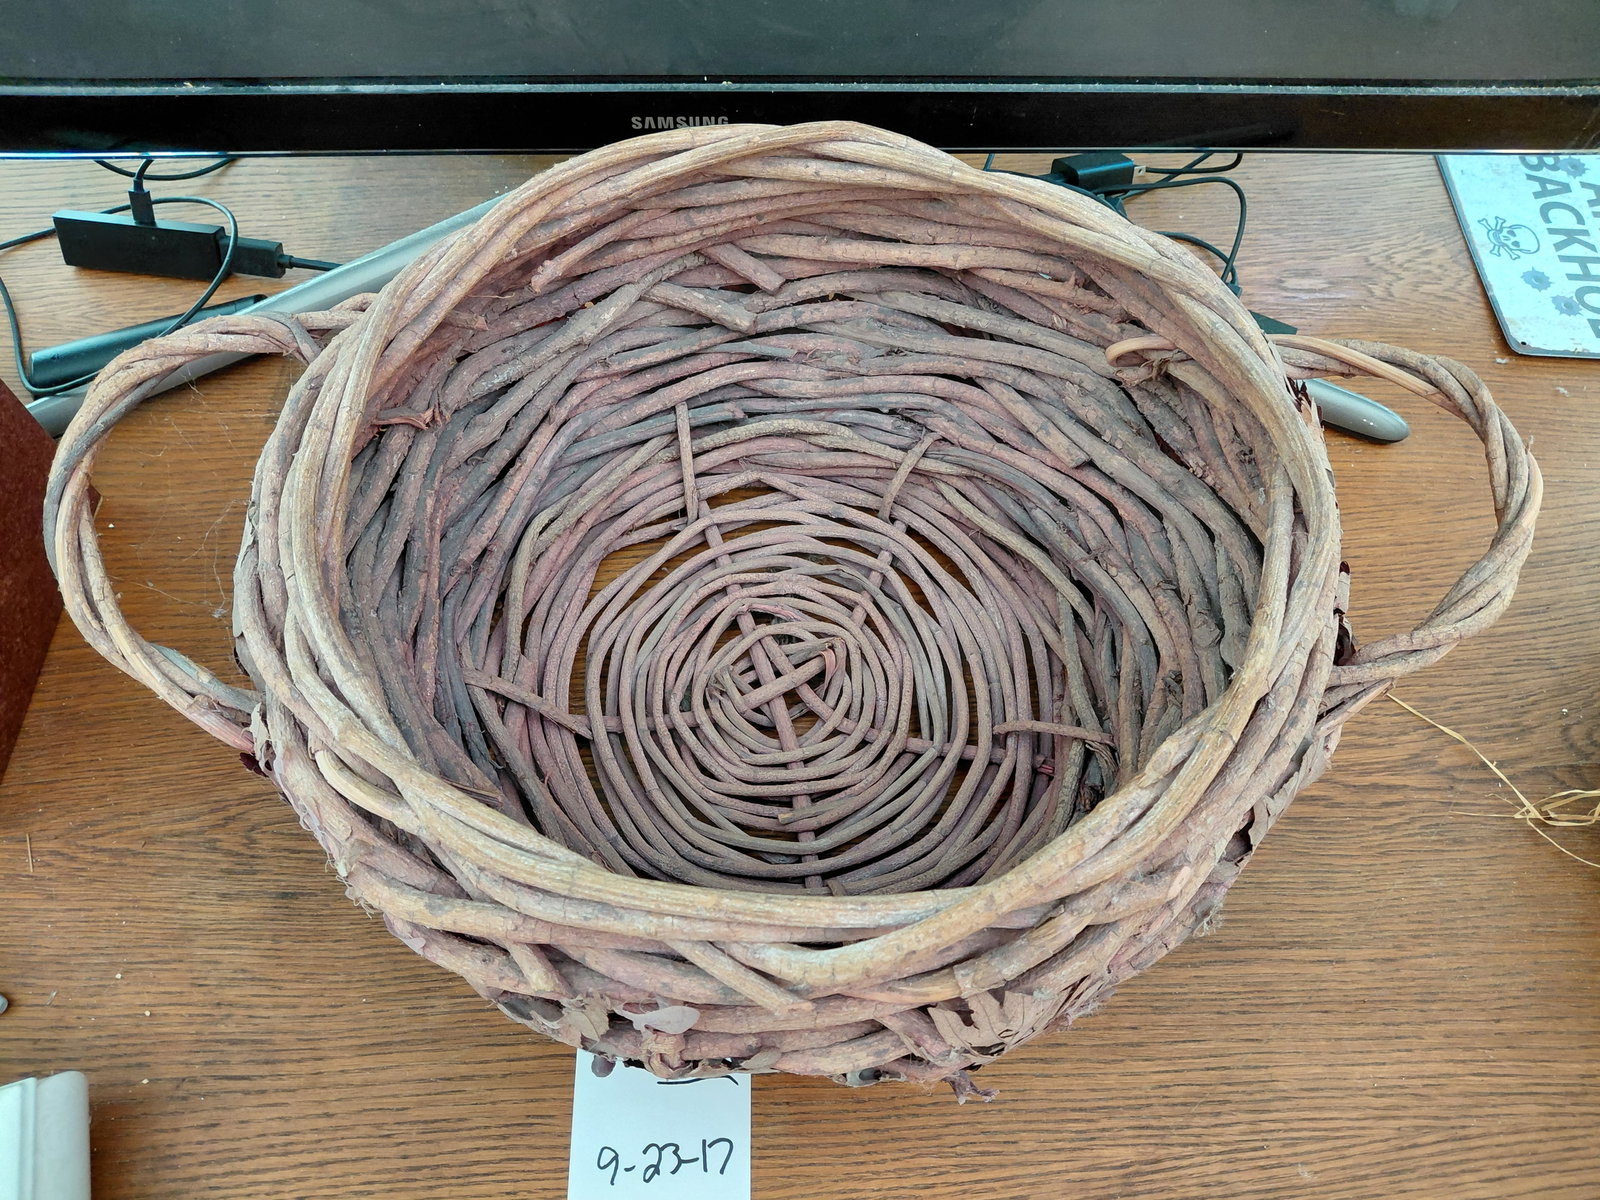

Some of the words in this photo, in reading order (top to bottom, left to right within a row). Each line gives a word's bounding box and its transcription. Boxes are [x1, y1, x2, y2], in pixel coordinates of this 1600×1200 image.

[631, 115, 729, 129] SAMSUNG
[1519, 155, 1600, 338] BACKHO
[597, 1138, 733, 1186] 9-23-17
